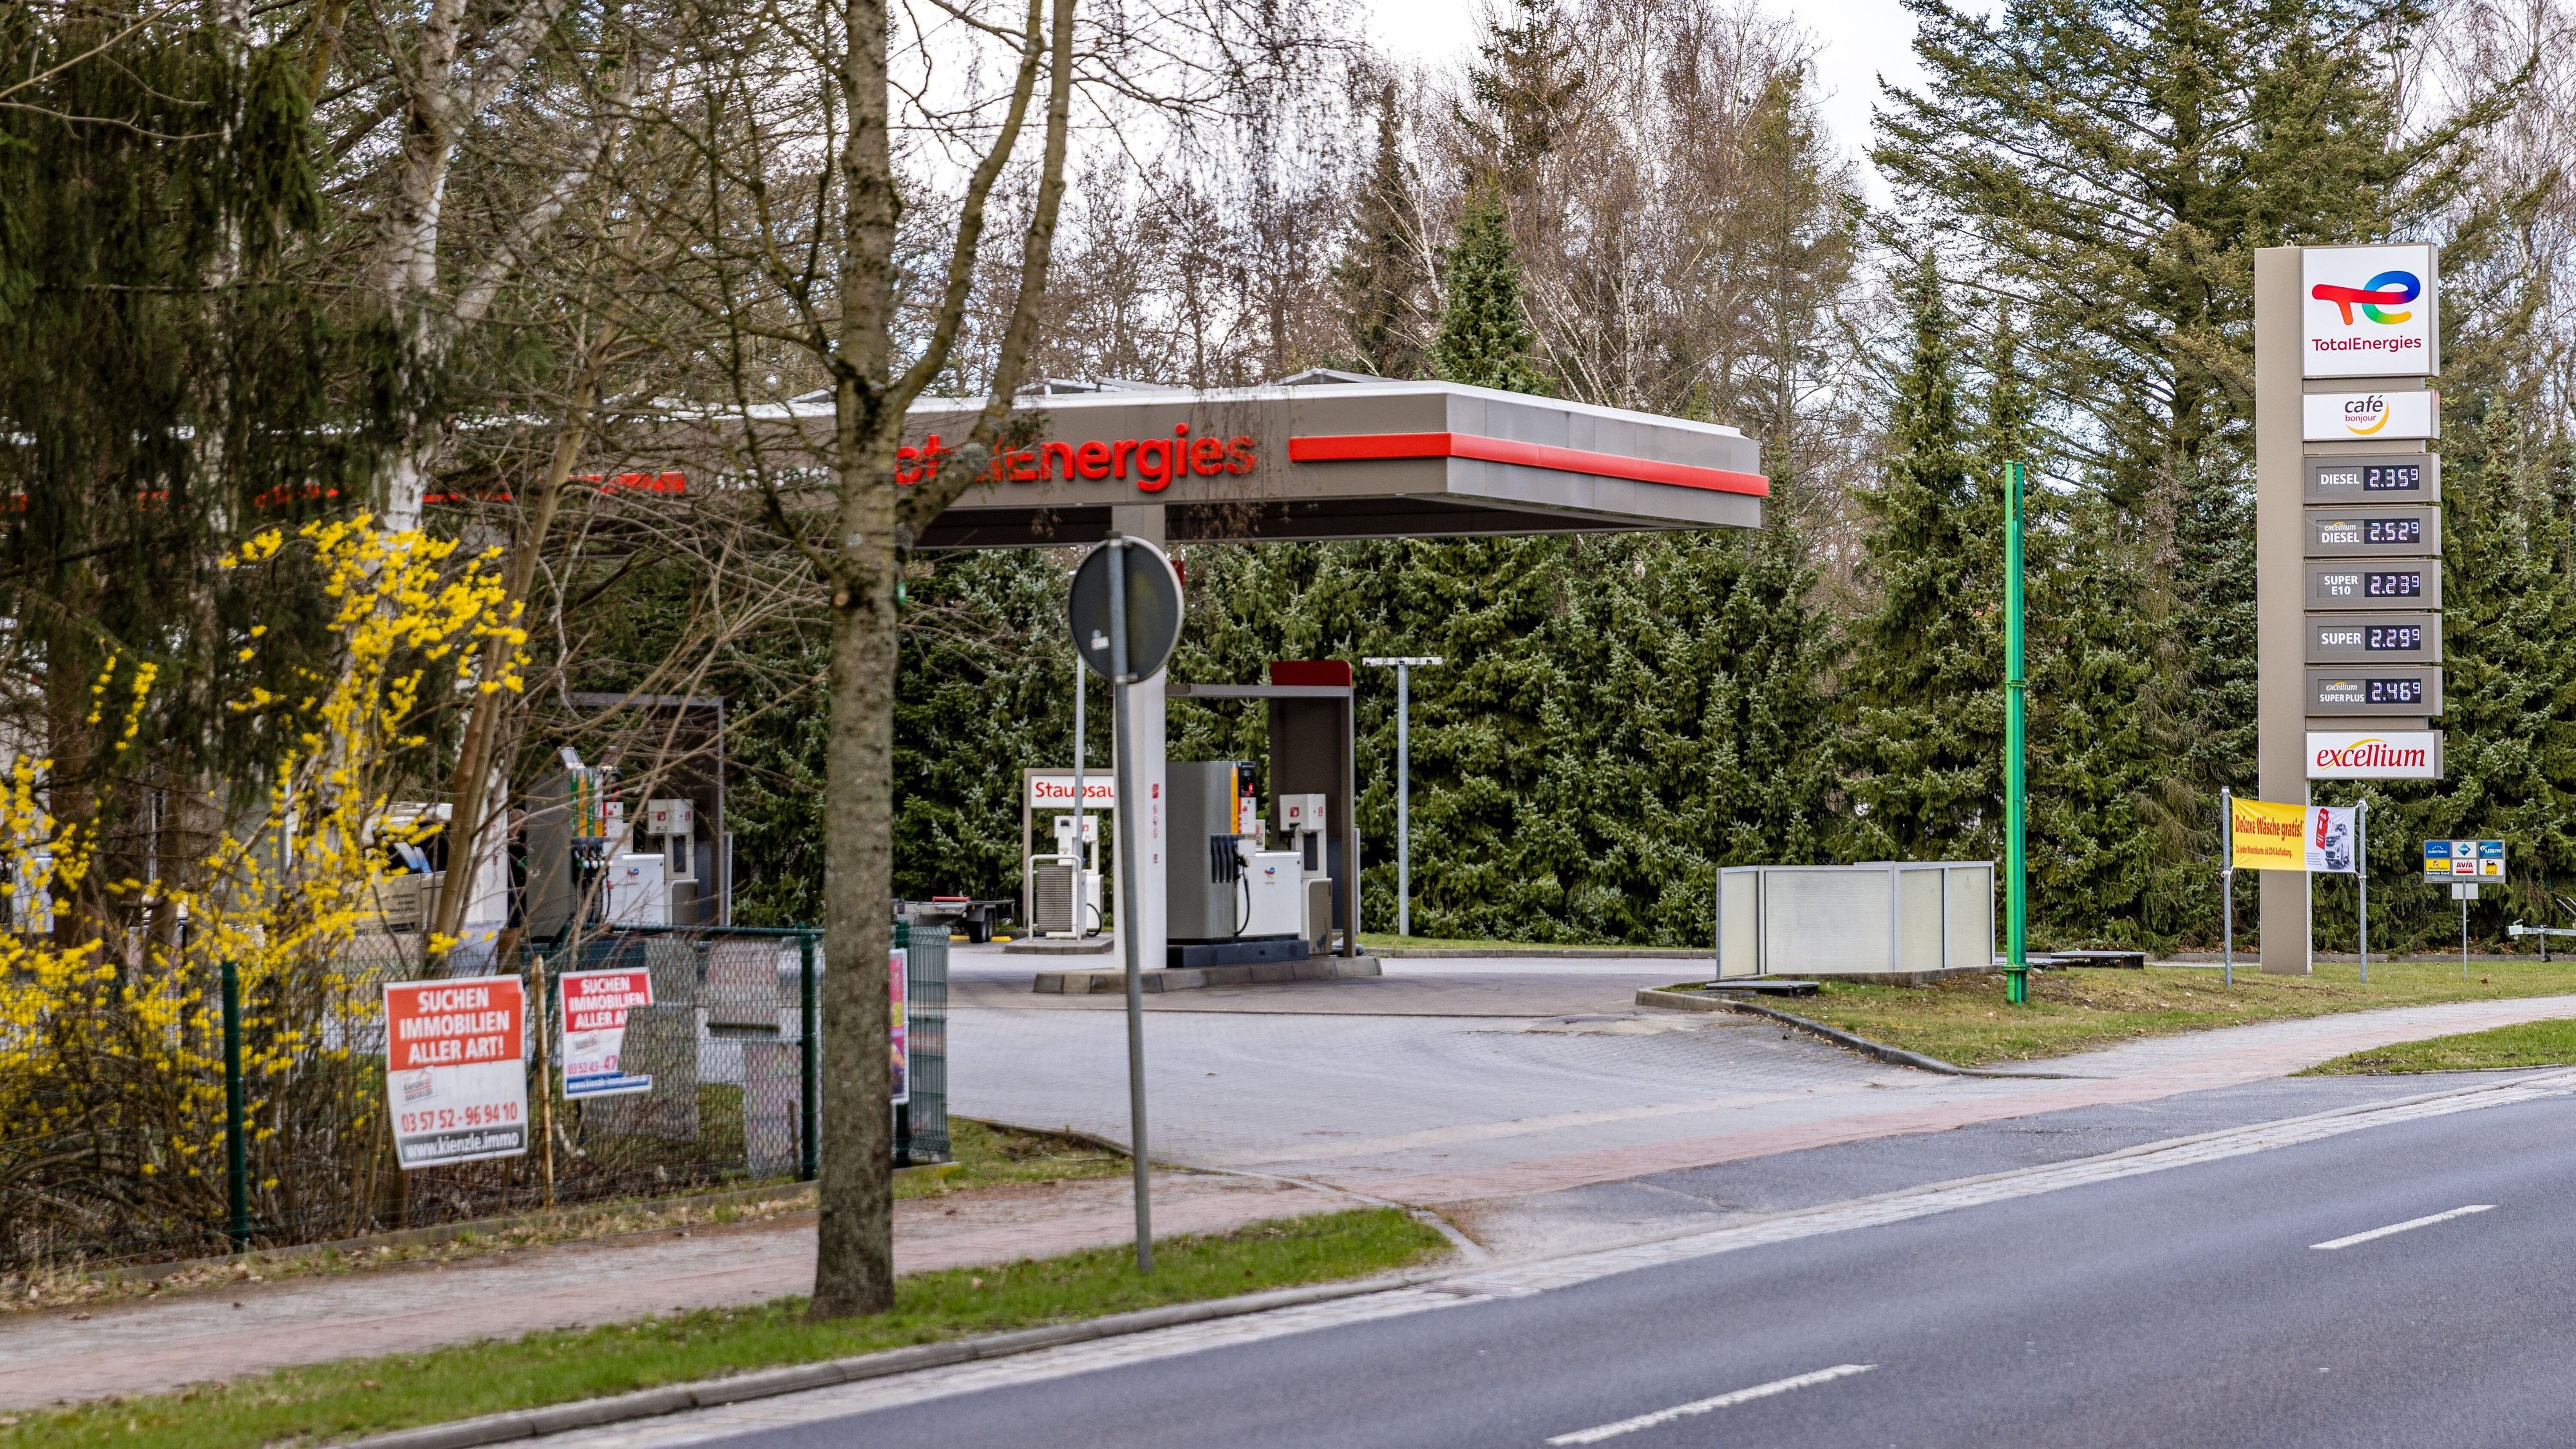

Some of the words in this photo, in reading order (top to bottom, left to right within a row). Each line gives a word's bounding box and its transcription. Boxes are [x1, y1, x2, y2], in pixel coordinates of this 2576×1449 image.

[2311, 335, 2421, 352] TotalEnergies
[2344, 395, 2383, 413] café
[2345, 414, 2377, 423] bonjour
[2320, 473, 2360, 485] DIESEL
[2324, 522, 2356, 531] excellium
[2321, 532, 2360, 543] DIESEL
[2324, 575, 2358, 585] SUPER
[2331, 585, 2351, 595] E10
[2321, 632, 2362, 645] SUPER
[2325, 683, 2358, 691] excellium
[2316, 743, 2425, 767] excellium
[1035, 781, 1114, 798] Stausau
[2235, 814, 2256, 834] Deluxe
[2257, 815, 2280, 836] Wäsche
[580, 976, 630, 995] SUCHEN
[417, 987, 489, 1013] SUCHEN
[568, 991, 645, 1012] IMMOBILIEN
[399, 1009, 510, 1040] IMMOBILIEN
[574, 1010, 613, 1030] ALLER
[407, 1038, 463, 1066] ALLER
[464, 1035, 505, 1060] ART!
[401, 1112, 417, 1133] 03
[420, 1110, 435, 1132] 57
[439, 1108, 455, 1129] 52
[465, 1104, 482, 1126] 96
[484, 1103, 500, 1124] 94
[503, 1101, 518, 1121] 10
[404, 1131, 520, 1159] www.kienzle.immo
